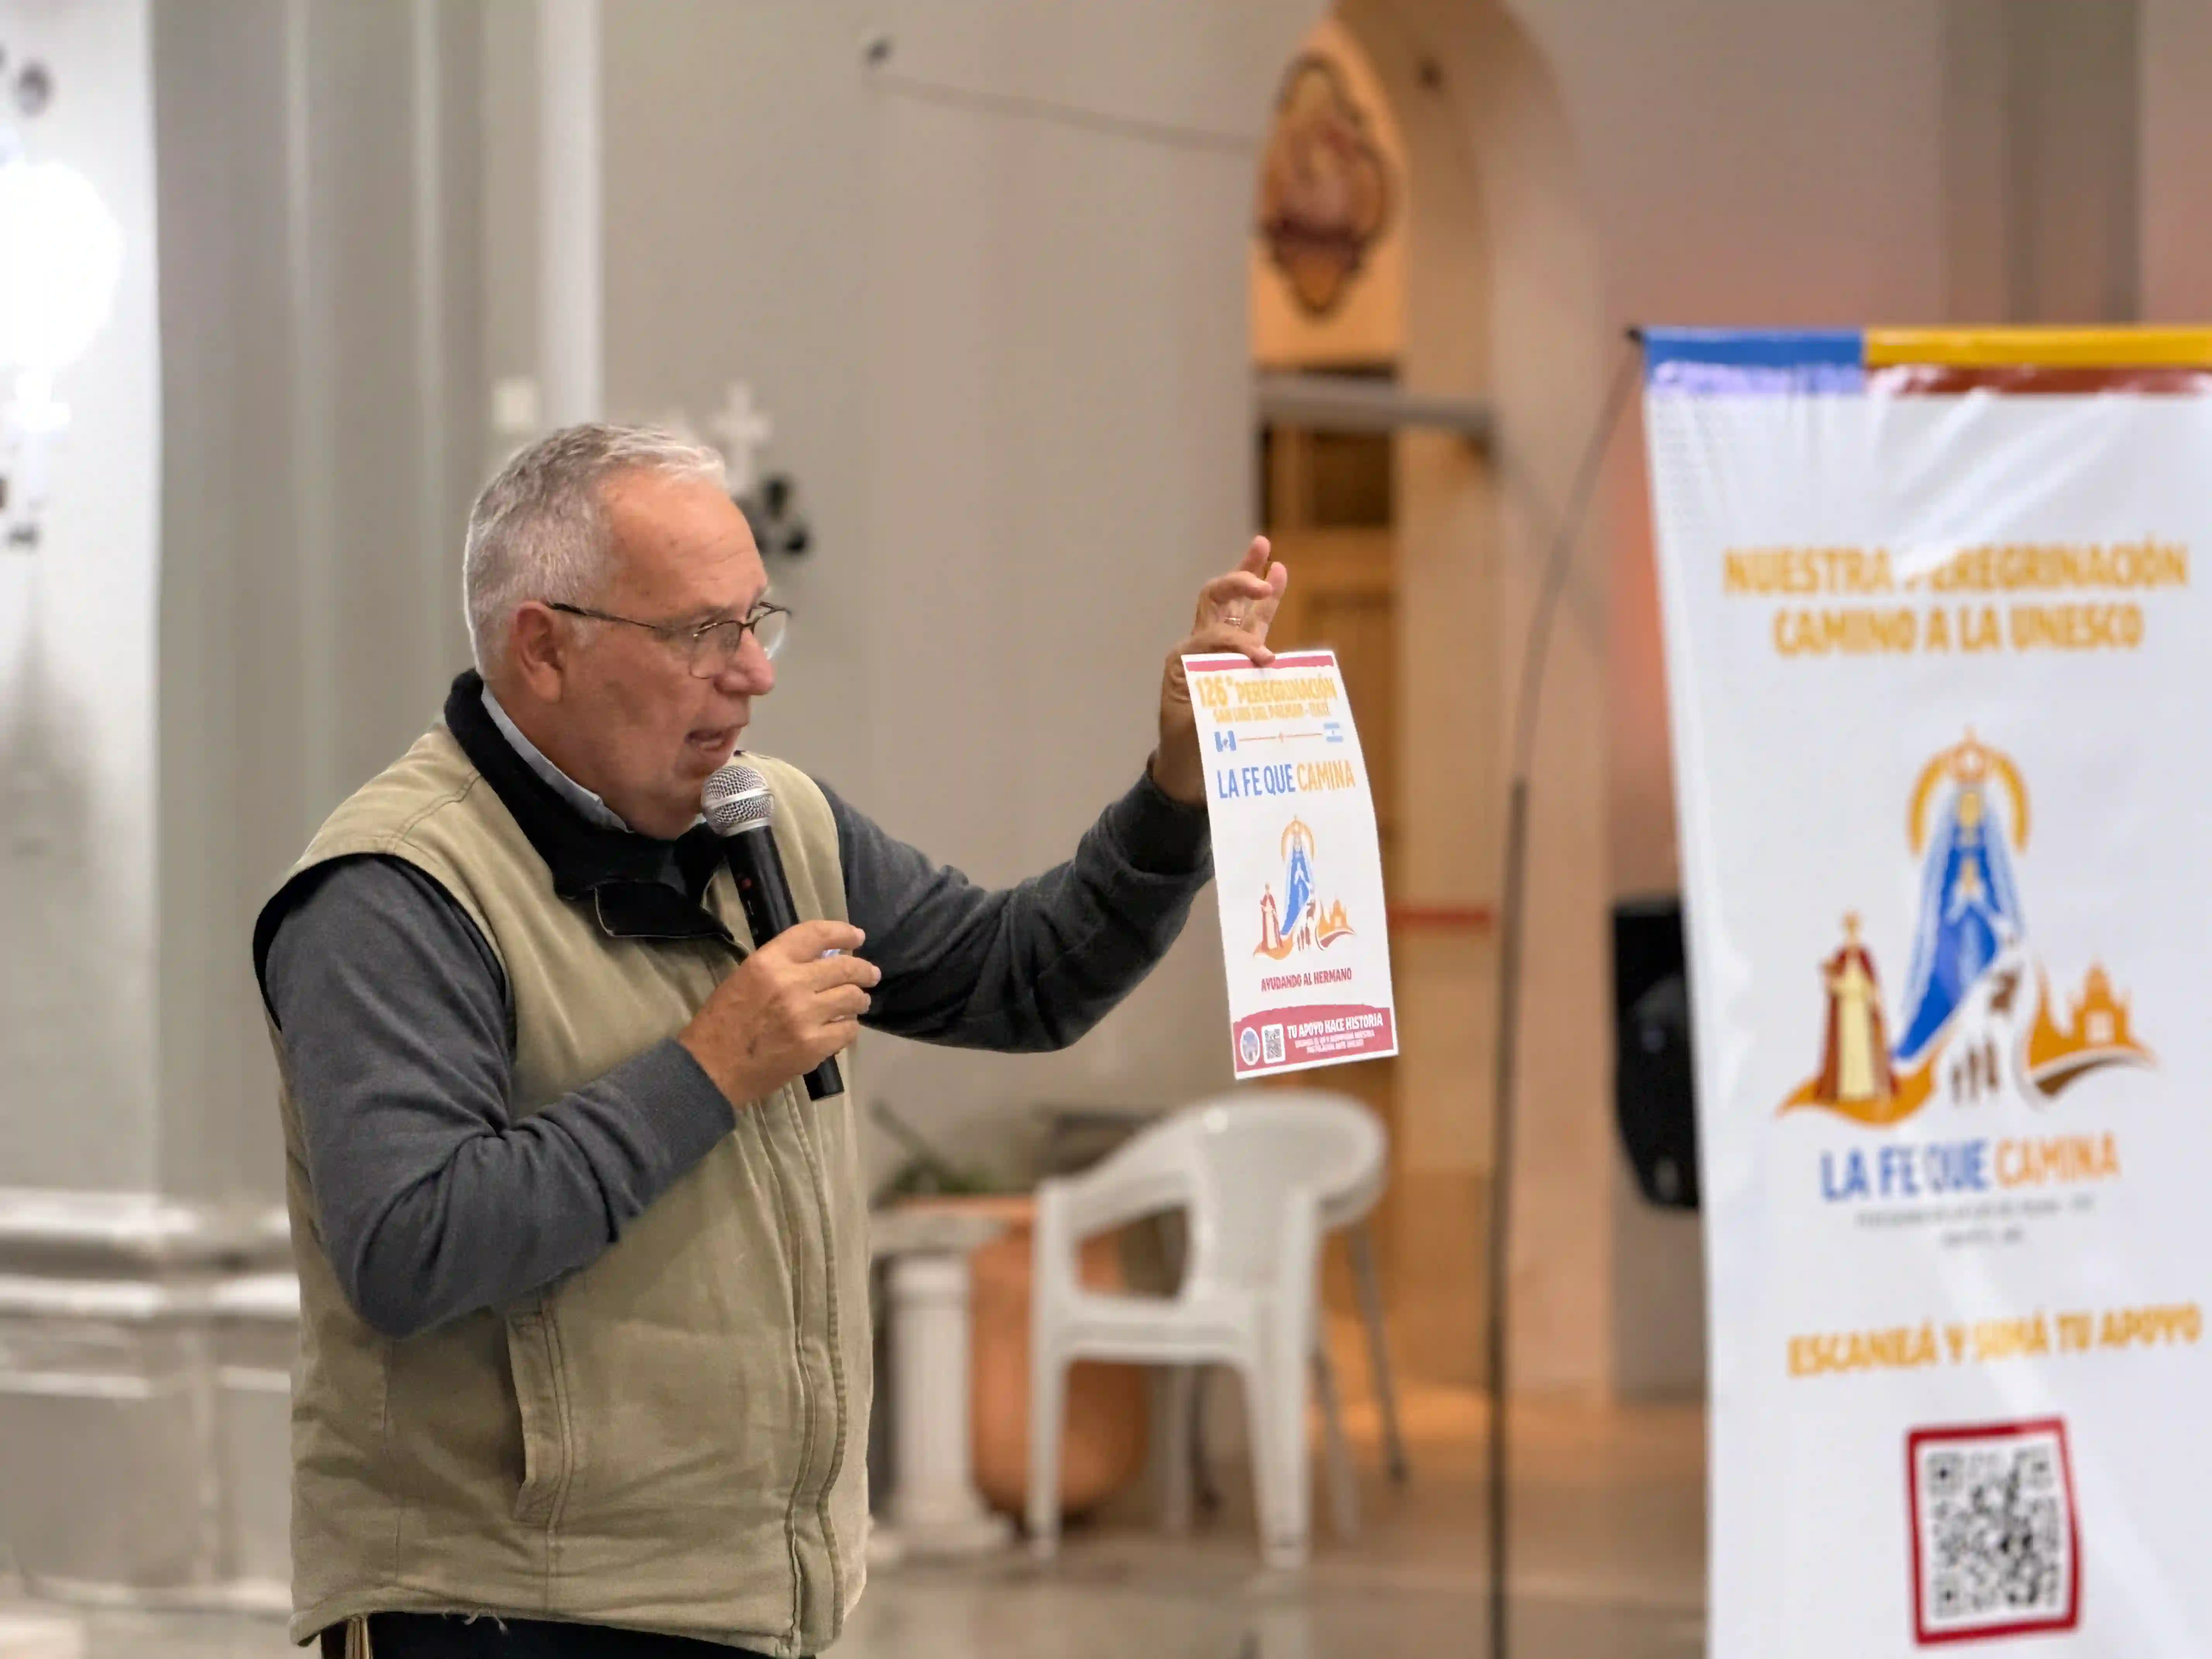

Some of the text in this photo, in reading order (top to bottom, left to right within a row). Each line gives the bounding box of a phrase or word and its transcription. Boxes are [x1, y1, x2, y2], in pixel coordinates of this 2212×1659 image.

[1723, 533, 2188, 596] NUESTRA EREGRINACIÓN
[1772, 601, 2143, 657] CAMINO A LA UNESCO
[1217, 759, 1355, 798] LA FE QUE CAMINA
[1261, 967, 1352, 992] AYUDANDO AL HERMANO
[1287, 1025, 1297, 1039] TU
[1299, 1021, 1324, 1037] APOYO
[1324, 1018, 1345, 1033] HACE
[1346, 1013, 1383, 1030] HISTORIA
[1819, 1131, 2121, 1203] LA FE QUE CAMINA
[1942, 1322, 1966, 1365] Y
[2054, 1310, 2093, 1354] TU
[2097, 1302, 2203, 1349] APOYO
